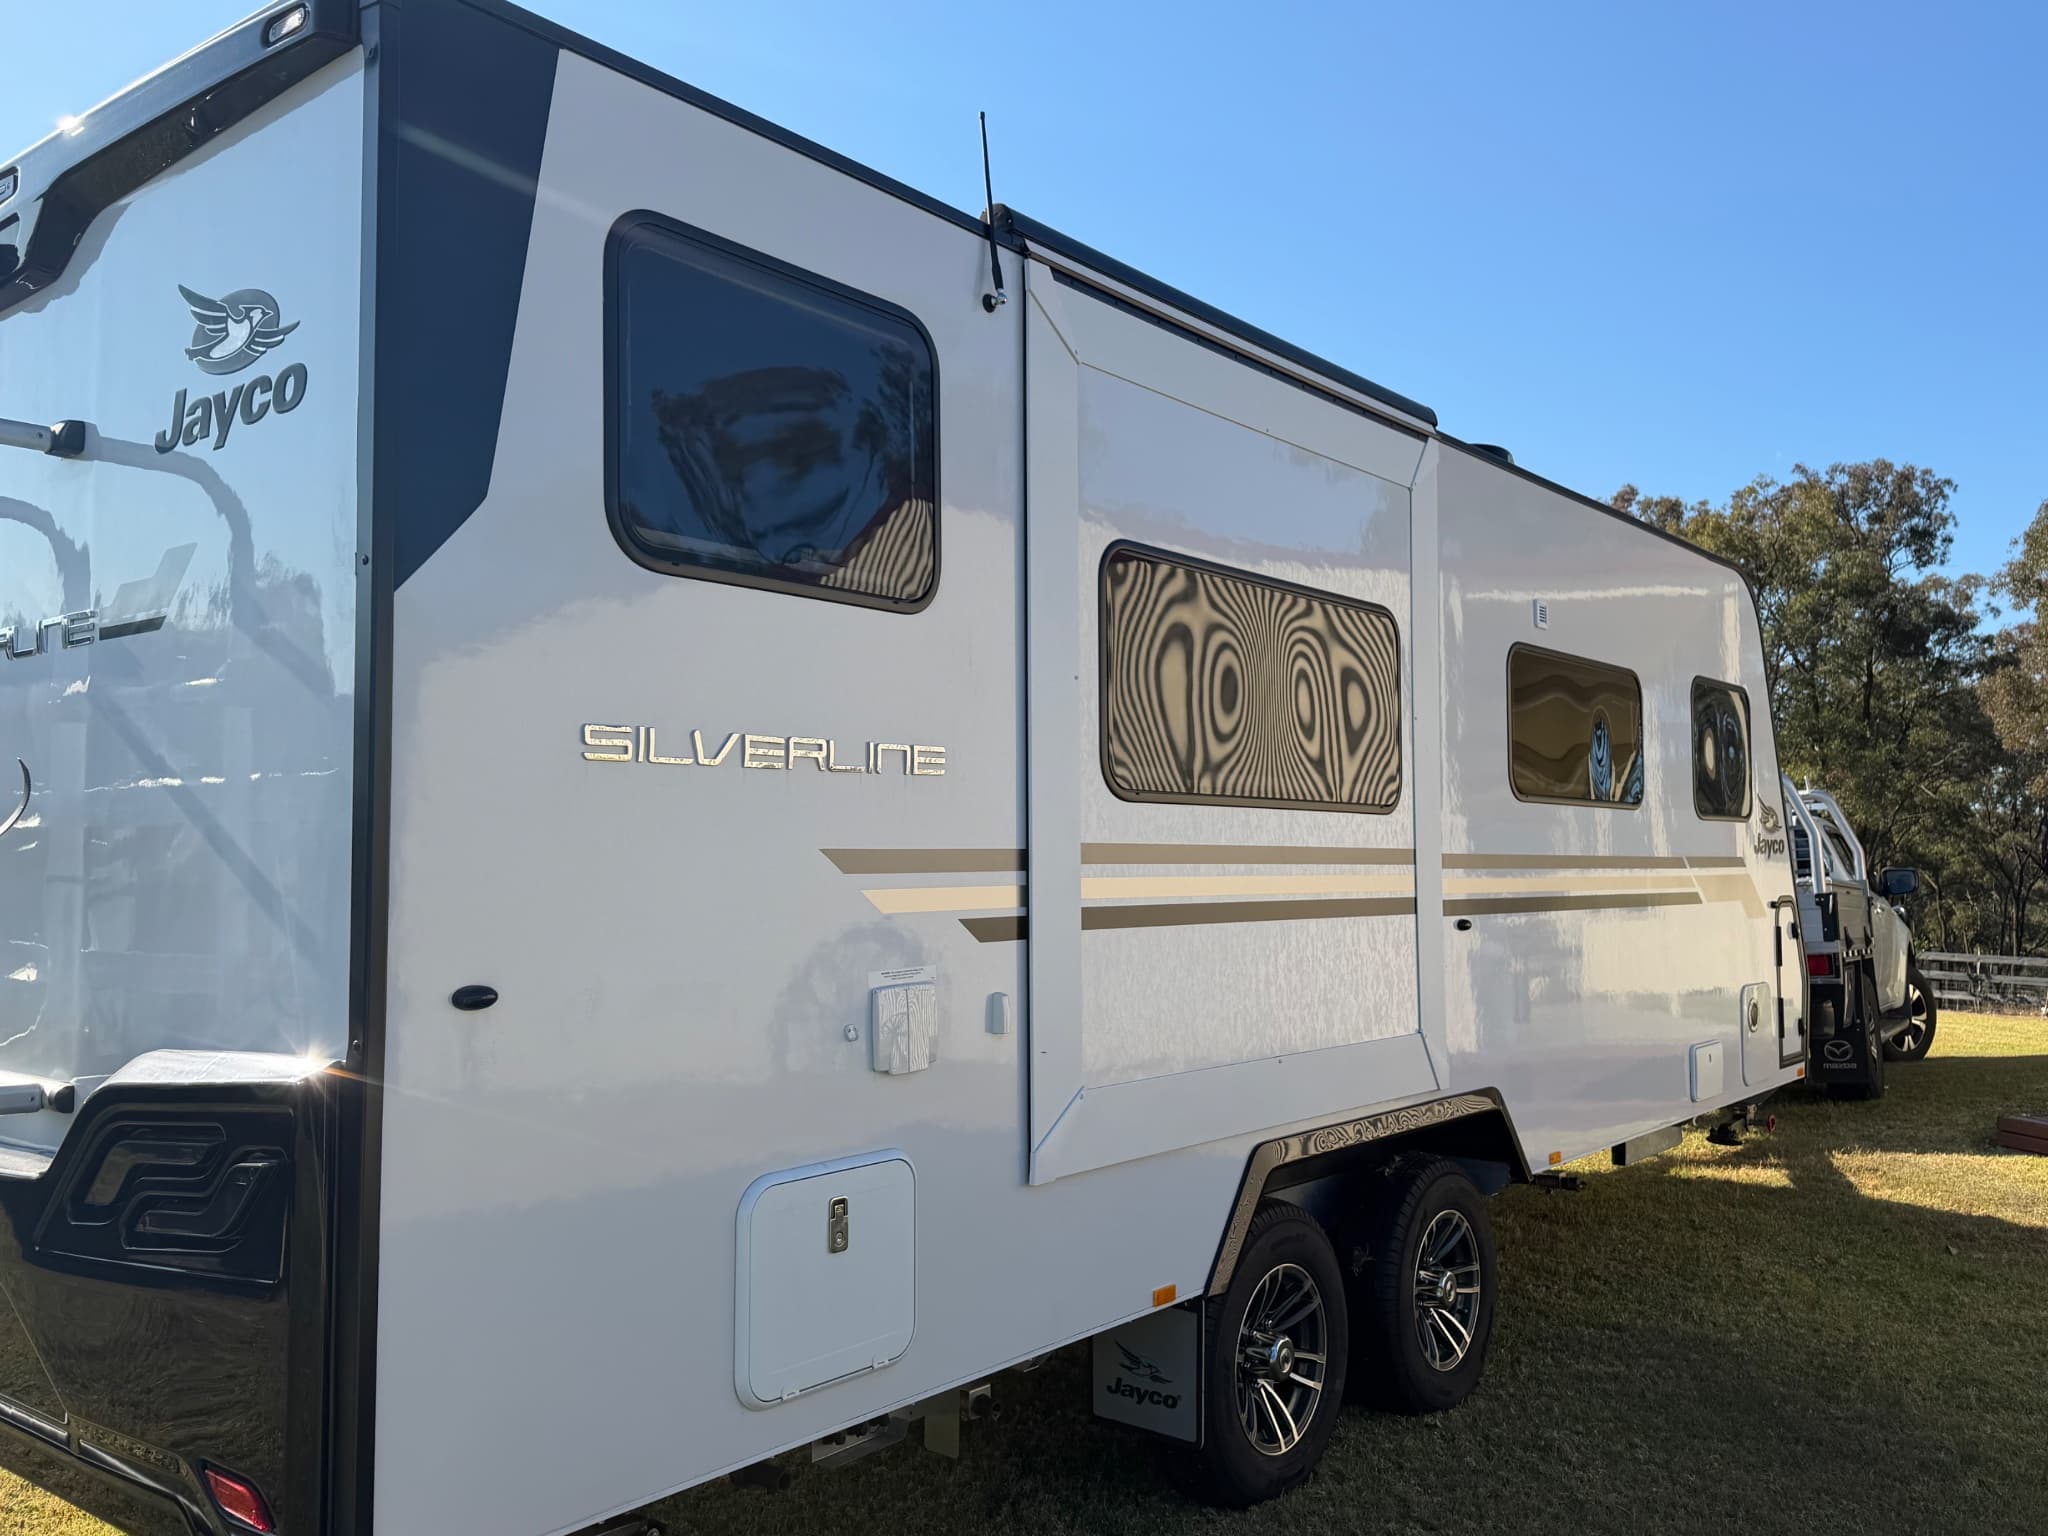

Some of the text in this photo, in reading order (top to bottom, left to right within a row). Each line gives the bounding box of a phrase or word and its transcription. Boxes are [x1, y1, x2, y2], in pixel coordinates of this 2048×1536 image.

[154, 362, 308, 454] Jayco
[581, 723, 946, 776] SILVERLINE
[1753, 832, 1785, 860] Jayco
[1106, 1377, 1178, 1409] Jayco
